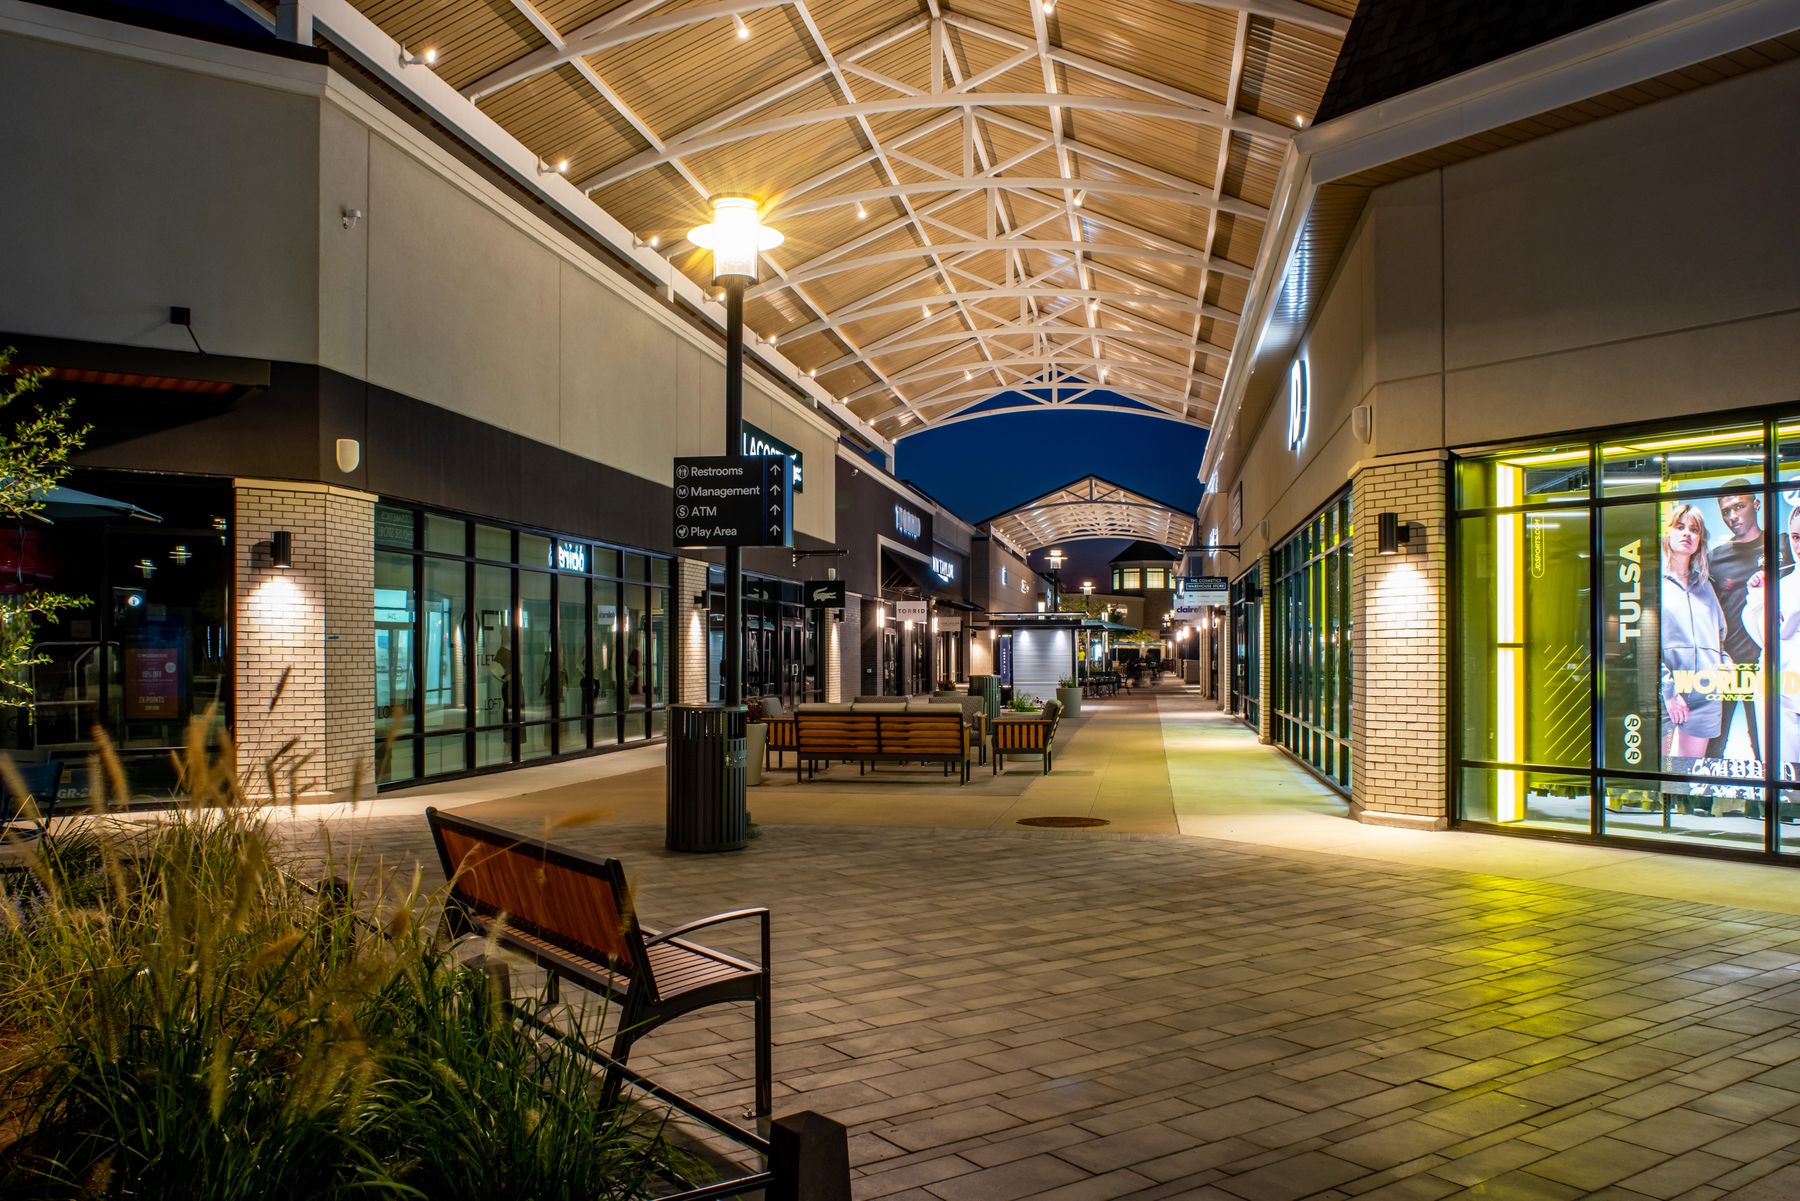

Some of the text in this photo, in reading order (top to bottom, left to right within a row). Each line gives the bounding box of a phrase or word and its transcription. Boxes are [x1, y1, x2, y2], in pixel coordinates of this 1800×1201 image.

[690, 466, 743, 477] Restrooms
[690, 485, 761, 498] Management
[691, 506, 717, 517] ATM
[690, 526, 737, 538] Play Area
[1619, 538, 1642, 643] TULSA
